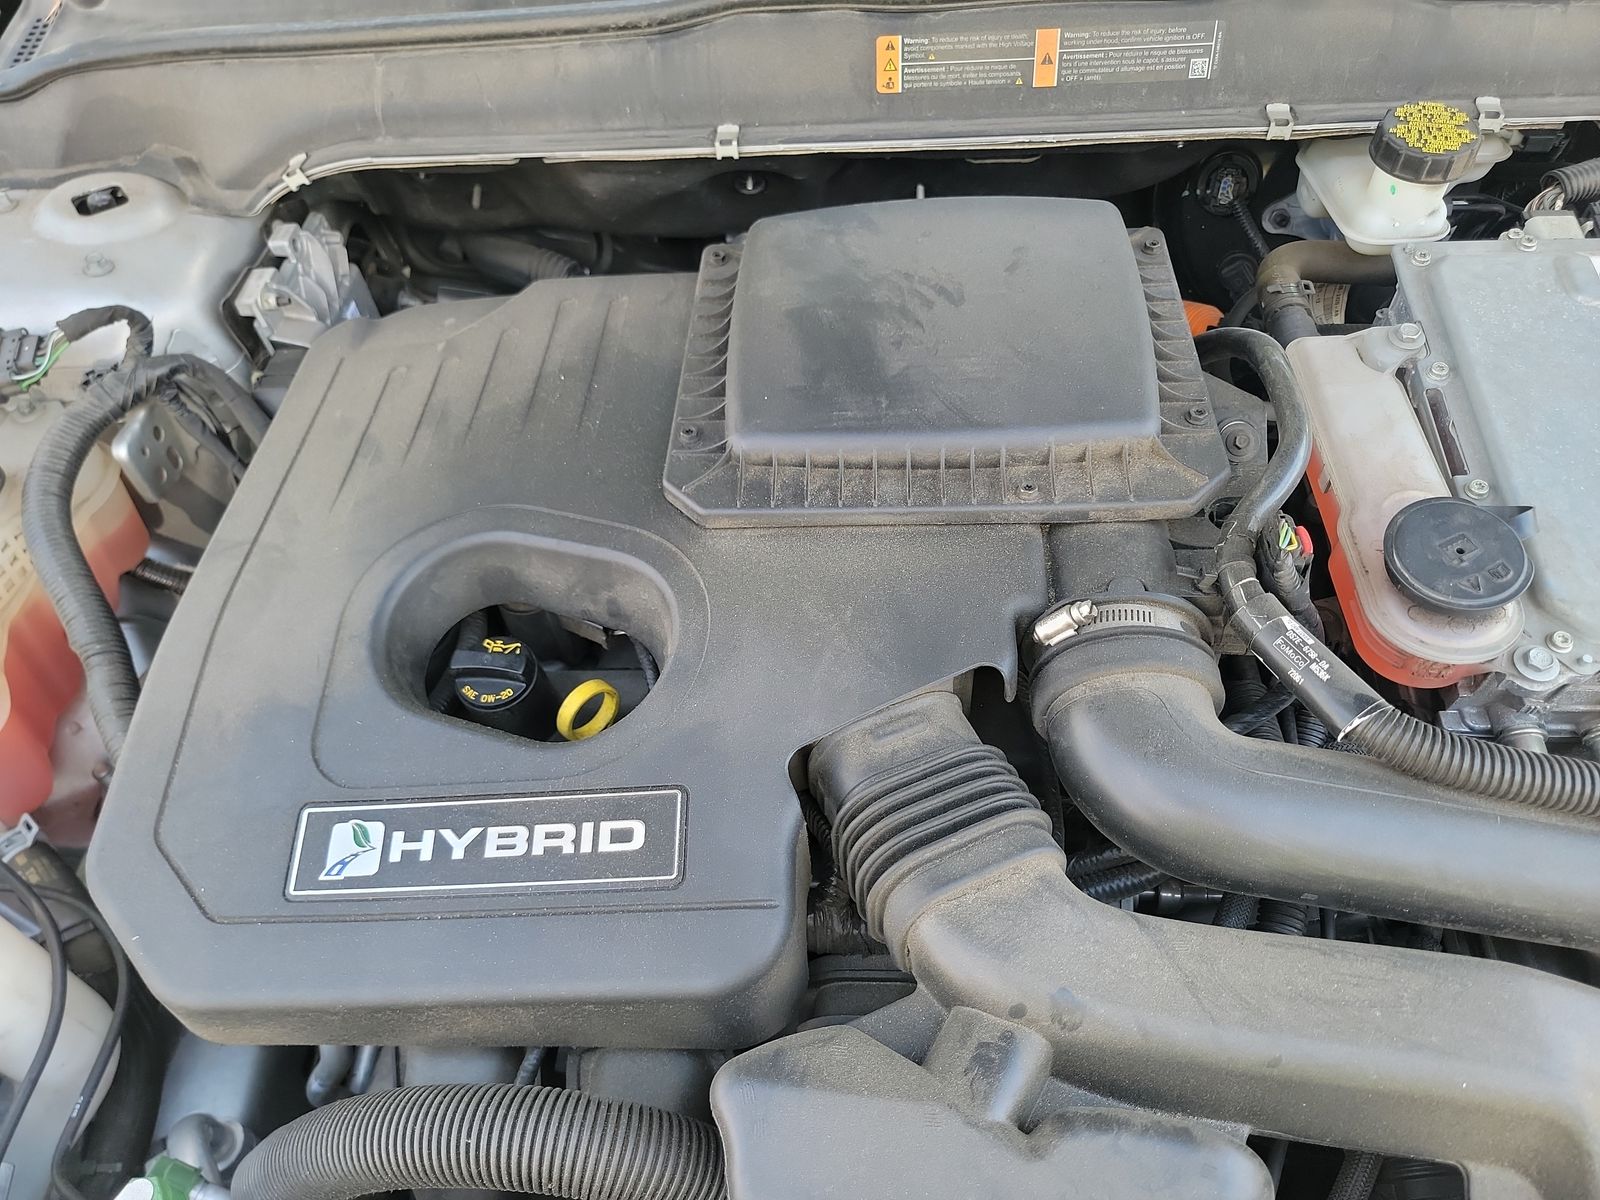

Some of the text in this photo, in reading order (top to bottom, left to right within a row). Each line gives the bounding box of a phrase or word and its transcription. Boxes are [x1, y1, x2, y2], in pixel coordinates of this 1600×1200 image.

[1276, 640, 1305, 668] FoMoCo
[462, 685, 479, 700] SAE
[388, 819, 646, 863] HYBRID
